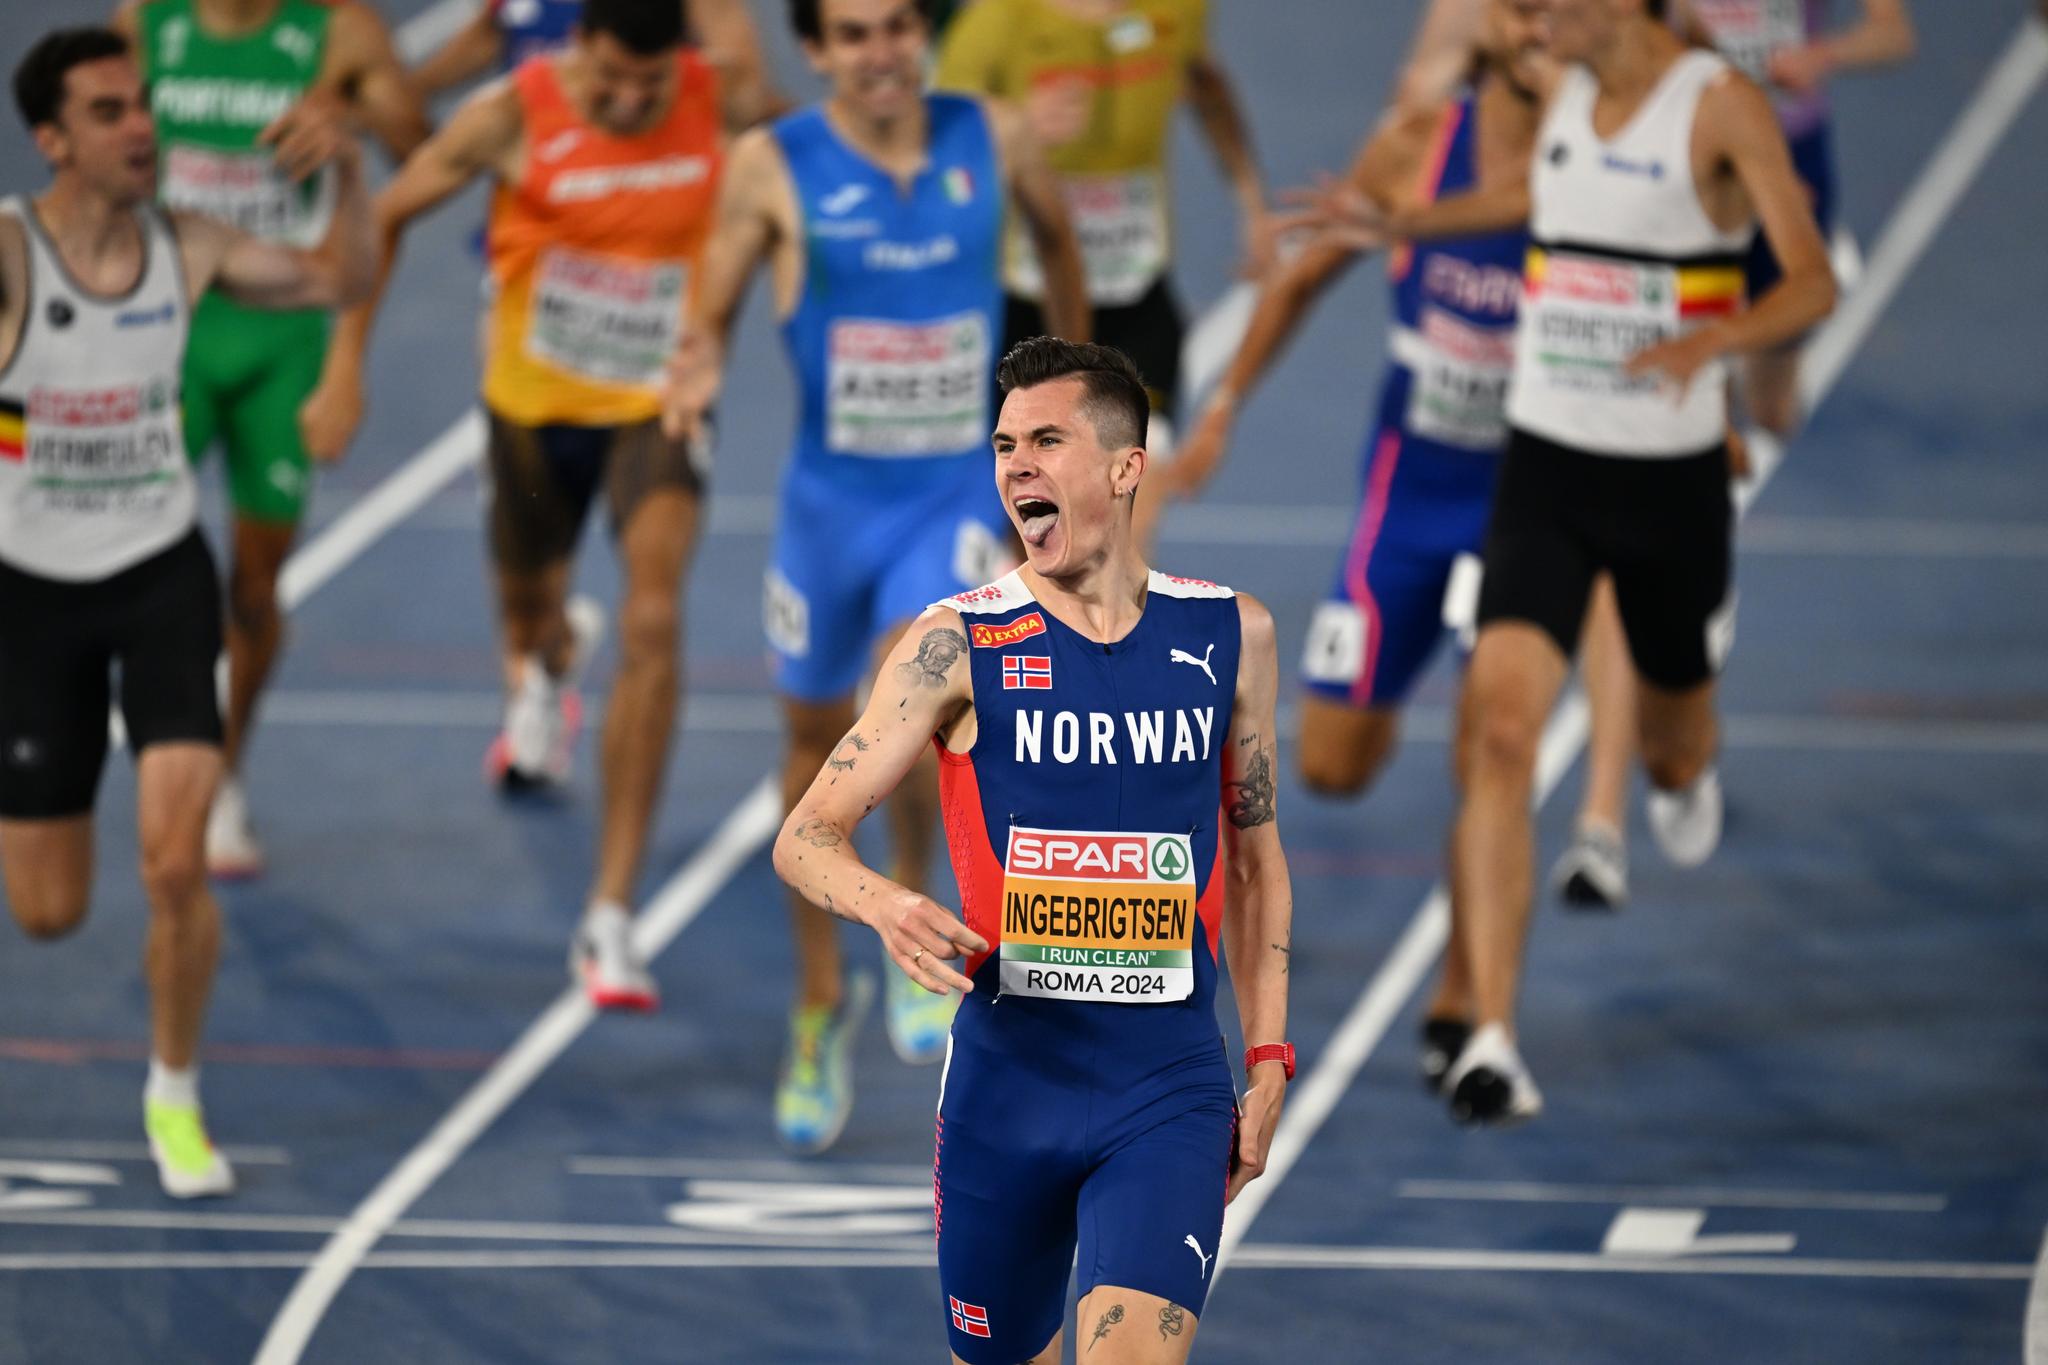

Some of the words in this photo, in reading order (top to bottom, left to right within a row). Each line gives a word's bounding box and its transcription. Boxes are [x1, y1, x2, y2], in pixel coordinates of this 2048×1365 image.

[994, 618, 1039, 641] EXTRA
[1015, 706, 1214, 764] NORWAY
[1012, 837, 1145, 873] SPAR
[1005, 891, 1187, 941] INGEBRIGTSEN
[1041, 947, 1046, 961] I
[1050, 947, 1088, 964] RUN
[1027, 969, 1103, 993] ROMA
[1111, 974, 1166, 995] 2024
